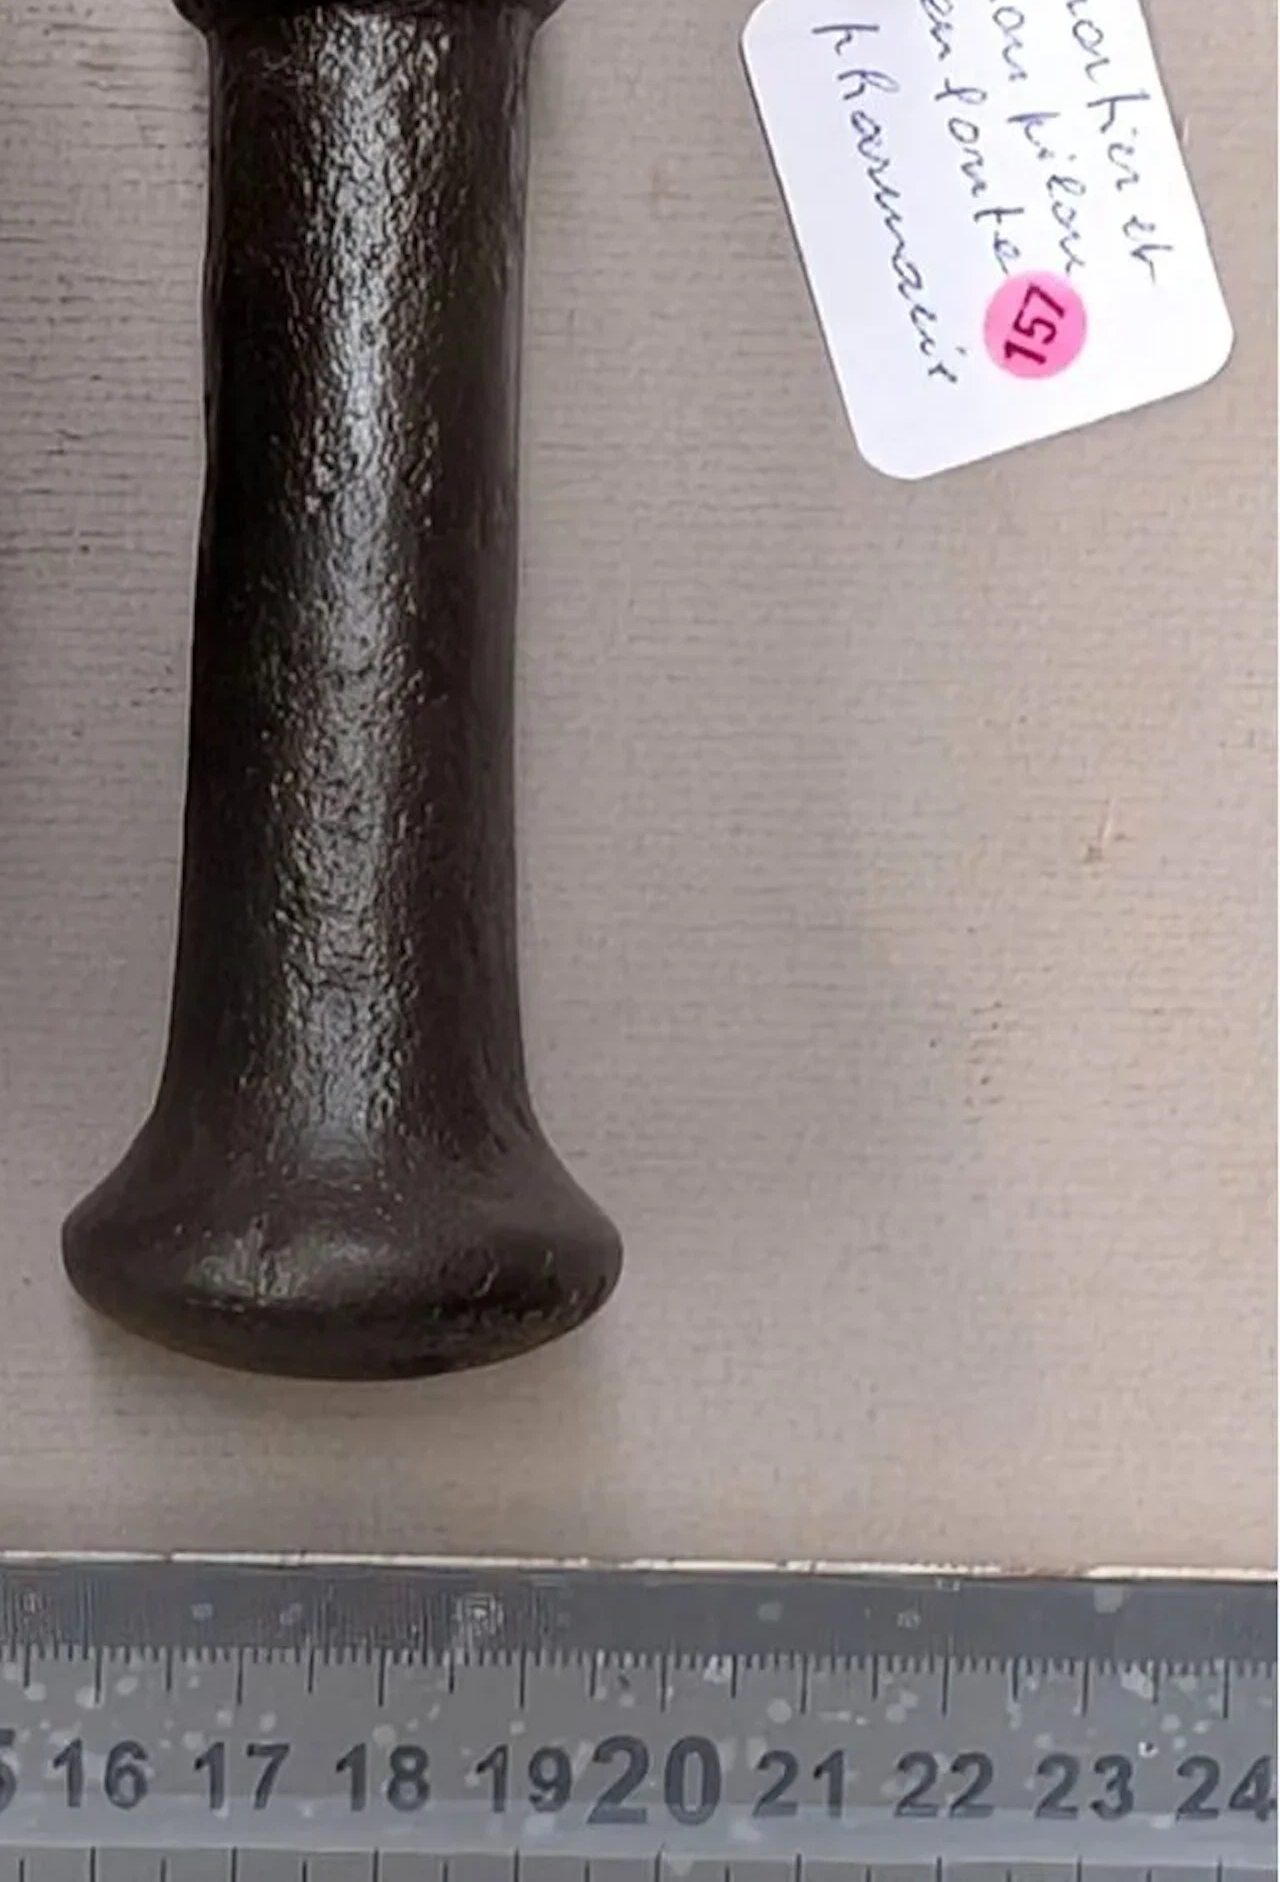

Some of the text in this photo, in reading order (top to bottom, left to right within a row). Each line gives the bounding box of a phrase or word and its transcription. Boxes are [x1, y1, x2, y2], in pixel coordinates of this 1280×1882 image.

[935, 76, 1024, 275] fonte
[1003, 285, 1068, 366] 157
[53, 1738, 149, 1810] 16
[193, 1741, 290, 1810] 17
[335, 1742, 430, 1812] 18
[475, 1744, 572, 1814] 19
[590, 1735, 723, 1826] 20
[753, 1749, 845, 1818] 21
[894, 1751, 994, 1819] 22
[1034, 1753, 1134, 1820] 23
[1175, 1754, 1280, 1823] 24
